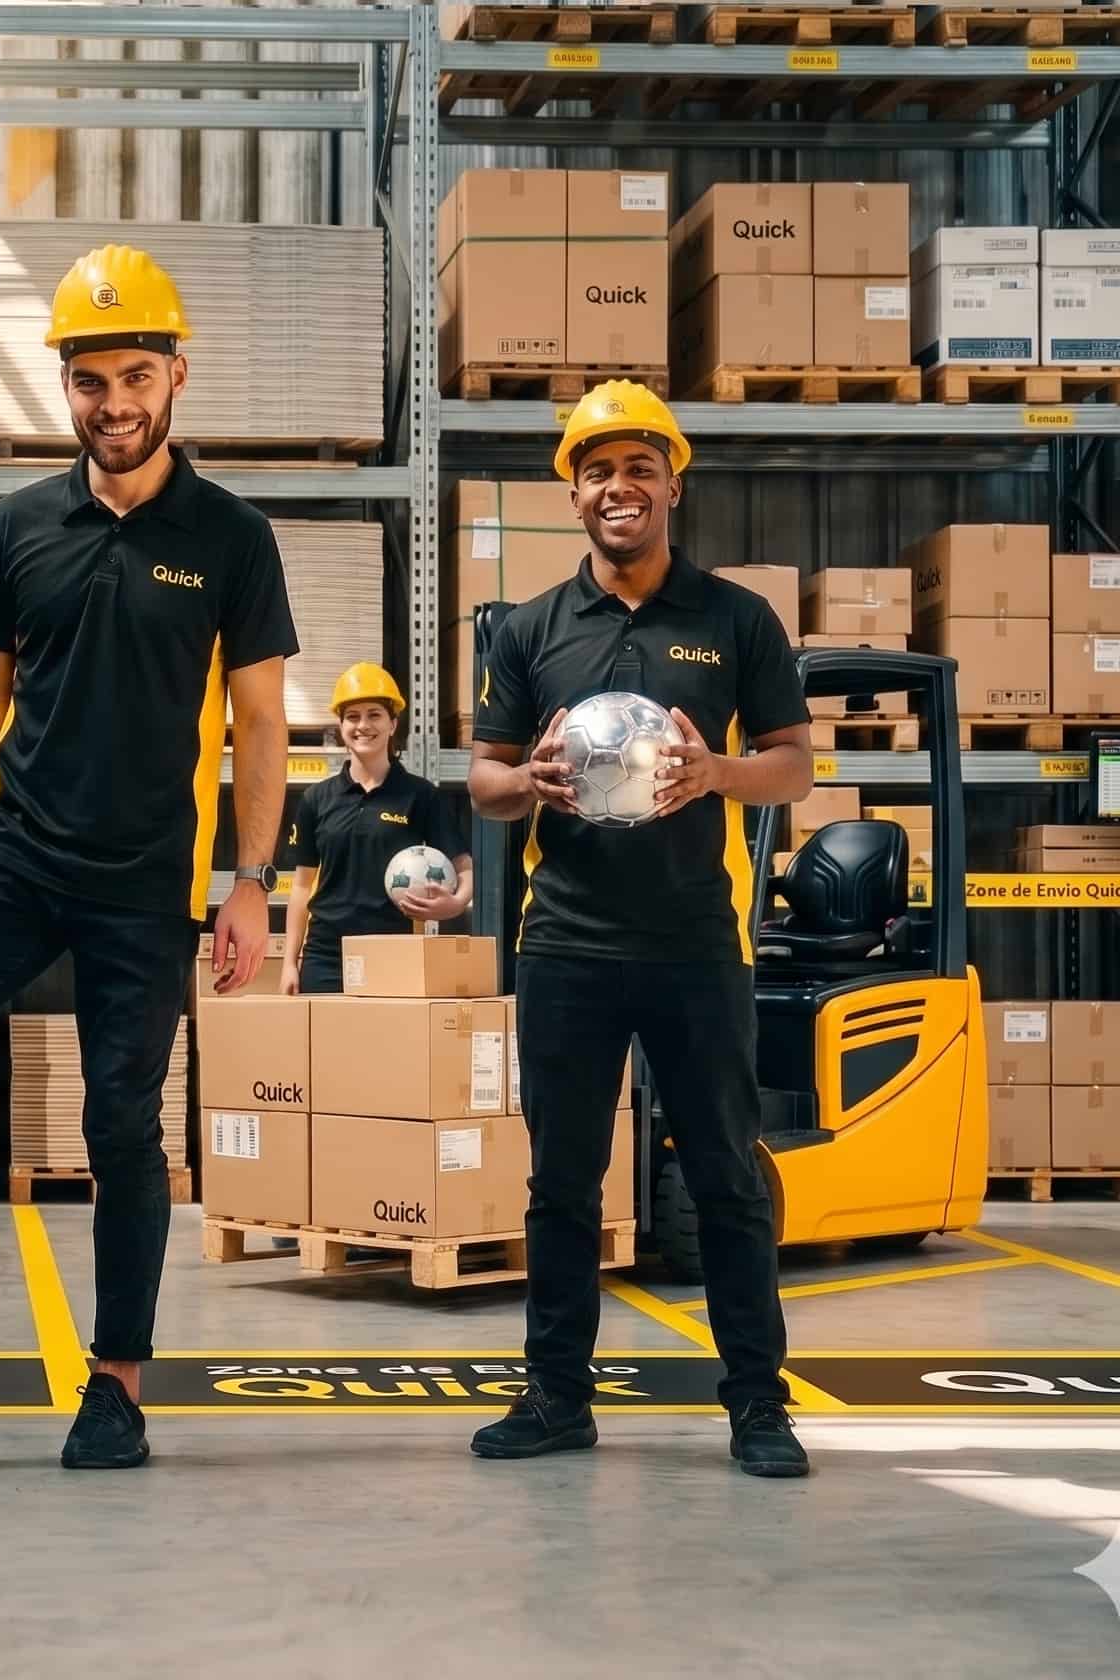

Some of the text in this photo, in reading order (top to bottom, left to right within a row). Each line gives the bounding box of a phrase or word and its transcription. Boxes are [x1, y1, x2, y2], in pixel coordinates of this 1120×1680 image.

[732, 219, 796, 240] Quick
[585, 285, 648, 305] Quick
[153, 564, 205, 589] Quick
[668, 644, 721, 665] Quick
[966, 883, 1007, 897] Zone
[1012, 882, 1031, 897] de
[1037, 882, 1081, 897] Envio
[253, 1080, 304, 1104] Quick
[373, 1199, 428, 1225] Quick
[205, 1365, 360, 1376] Zone
[379, 1364, 454, 1375] de
